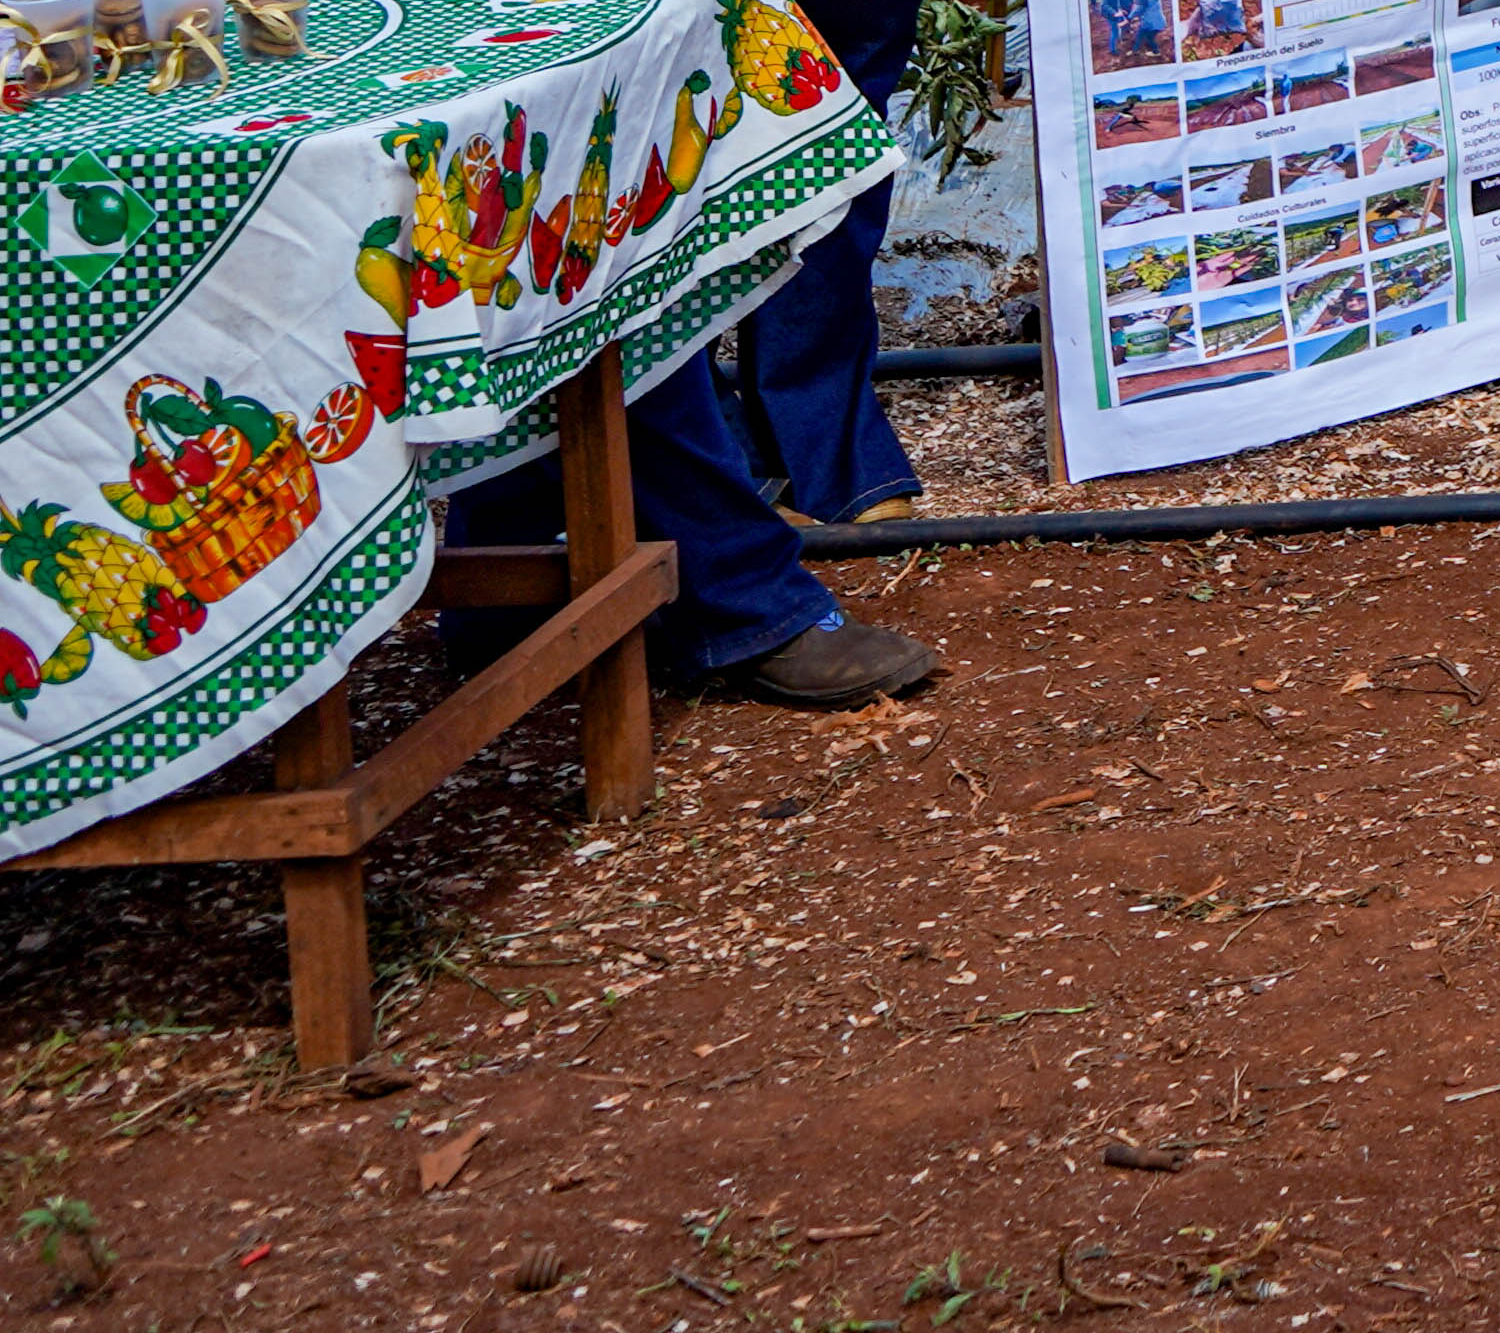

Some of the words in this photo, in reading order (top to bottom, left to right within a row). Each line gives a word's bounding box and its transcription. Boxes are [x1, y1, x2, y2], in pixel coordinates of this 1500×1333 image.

[1216, 49, 1278, 67] Preparación
[1280, 43, 1296, 56] del
[1298, 37, 1324, 51] Suelo
[1255, 125, 1296, 139] Siembra
[1238, 207, 1280, 223] Cuidados
[1282, 197, 1327, 213] Culturales
